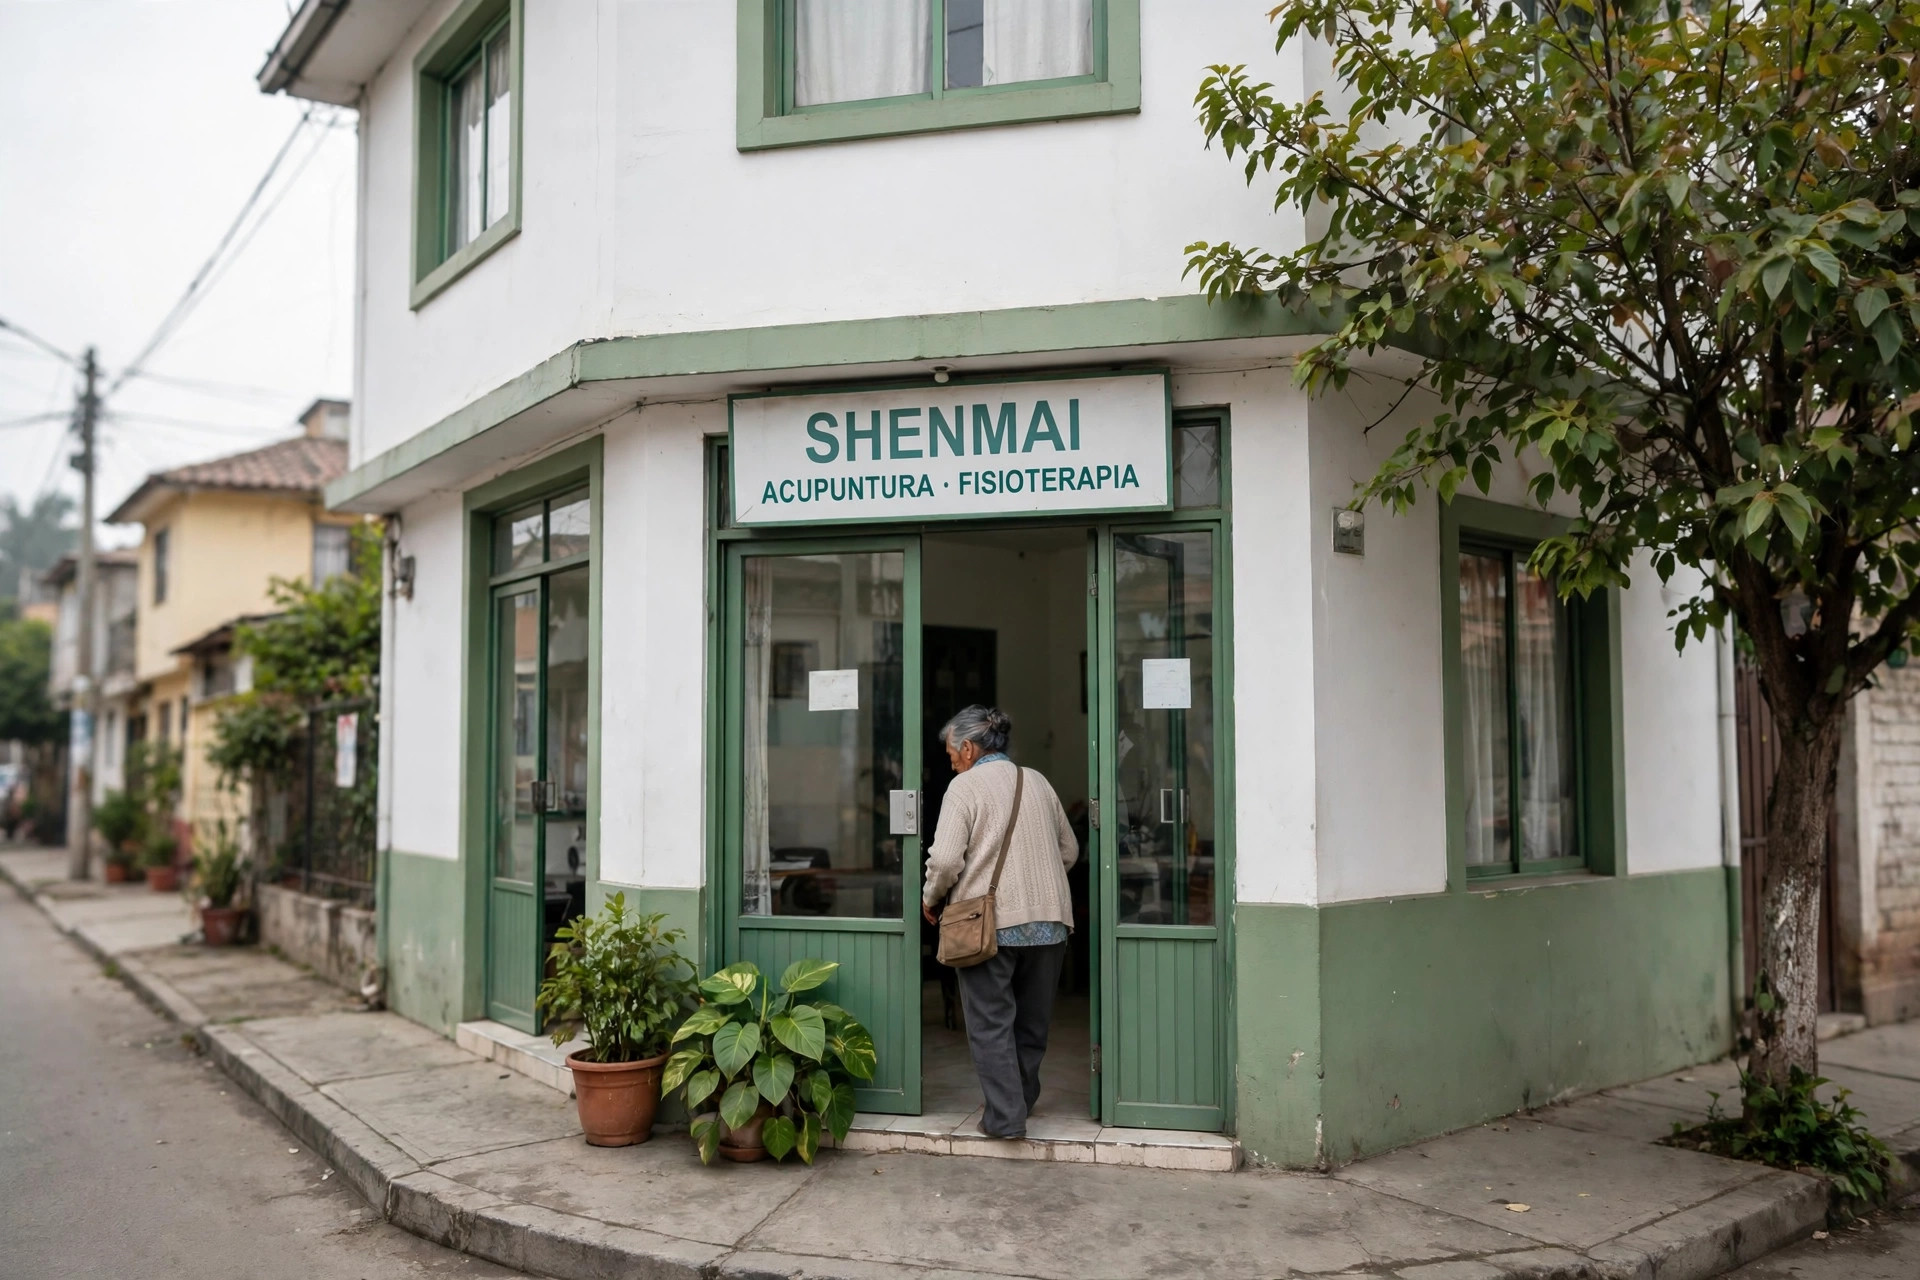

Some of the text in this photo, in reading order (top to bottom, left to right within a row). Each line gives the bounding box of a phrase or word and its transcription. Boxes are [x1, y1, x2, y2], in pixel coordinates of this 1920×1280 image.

[805, 398, 1081, 464] SHENMAI
[761, 473, 934, 504] ACUPUNTURA
[958, 463, 1140, 495] FISIOTERAPIA
